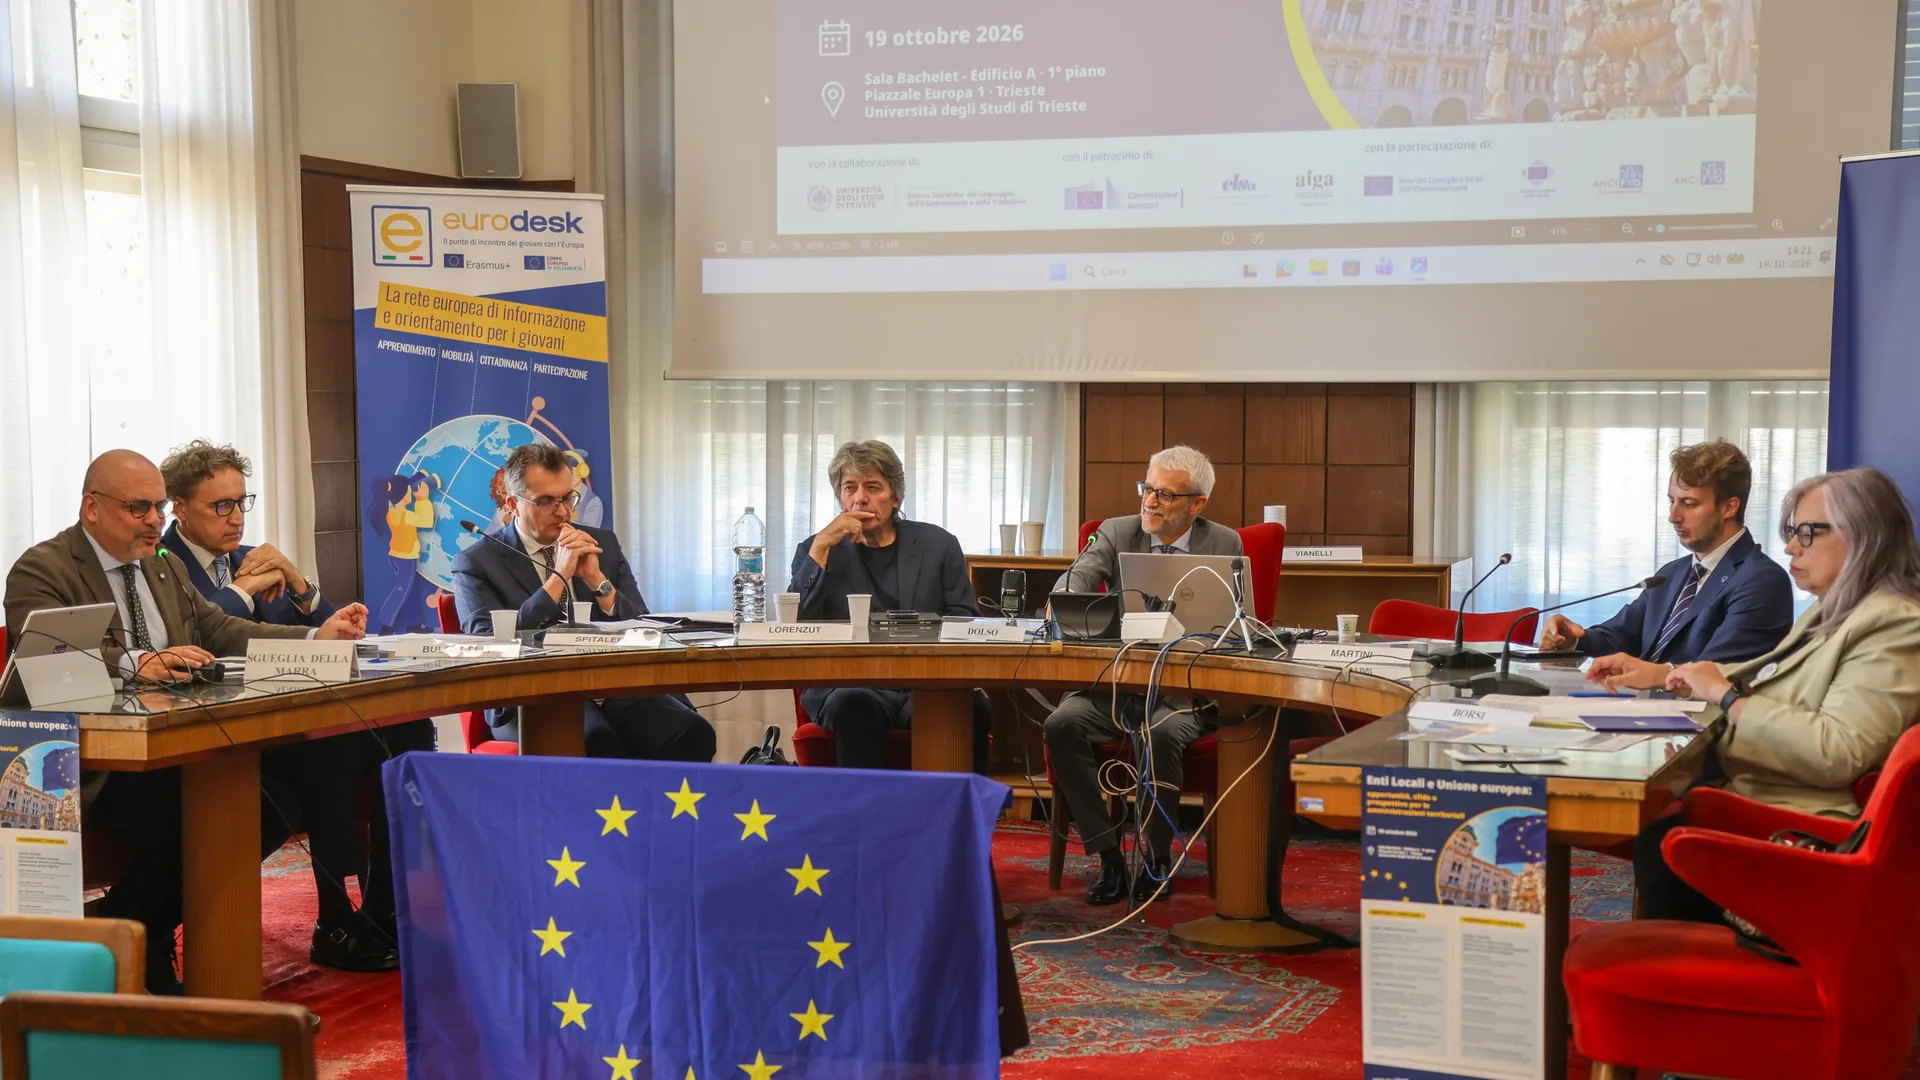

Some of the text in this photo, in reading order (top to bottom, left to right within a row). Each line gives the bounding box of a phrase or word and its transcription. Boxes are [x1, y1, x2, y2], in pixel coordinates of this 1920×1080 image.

[864, 24, 1024, 47] 19 ottobre 2026
[865, 72, 894, 85] Sala
[897, 70, 959, 84] Bachelet
[971, 67, 1022, 82] Edificio
[1026, 67, 1036, 80] A
[1048, 66, 1062, 79] 1°
[1065, 65, 1106, 81] piano
[865, 88, 921, 102] Piazzale
[925, 86, 973, 101] Europa
[977, 87, 984, 98] 1
[996, 84, 1045, 97] Trieste
[865, 99, 1087, 118] Università degli Studi di Trieste
[1365, 140, 1493, 154] con la partecipazione di:
[809, 160, 826, 169] con
[828, 157, 836, 168] la
[839, 156, 906, 168] collaborazione
[1063, 150, 1155, 164] con il patrocinio di:
[1222, 174, 1256, 192] elsa
[1295, 170, 1334, 190] aiga
[1593, 179, 1617, 188] ANCI
[1673, 175, 1698, 185] ANCI
[1128, 190, 1178, 200] Commissione
[836, 200, 876, 209] DI TRIESTE
[1128, 201, 1159, 211] europea
[443, 210, 584, 234] eurodesk
[449, 238, 469, 247] punto
[470, 238, 477, 246] di
[478, 239, 505, 247] incontro
[507, 239, 518, 247] dei
[519, 239, 542, 249] giovani
[557, 241, 584, 250] l'Europa
[1787, 246, 1812, 256] 14:21
[466, 260, 511, 270] Erasmus+
[1758, 258, 1812, 269] 19/10/2026
[1101, 265, 1127, 277] Cerca
[385, 285, 586, 333] La rete europea di informazione
[383, 311, 565, 351] e orientamento per i giovani
[377, 339, 588, 380] APPRENDIMENTO MOBILITÀ CITTADINANZA PARTECIPAZIONE
[768, 626, 821, 634] LORENZUT
[967, 627, 999, 636] DOLSO
[247, 653, 349, 664] SGUEGLIA DELLA
[1331, 649, 1373, 658] MARTINI
[275, 667, 317, 676] MARRA
[1452, 708, 1486, 720] BORSI
[0, 719, 68, 731] nione europea:
[1366, 775, 1389, 786] Enti
[1391, 776, 1425, 788] Locali
[1436, 780, 1478, 792] Unione
[1480, 784, 1532, 796] europea:
[1366, 799, 1408, 808] prospettive
[1366, 807, 1465, 819] amministrazioni territoriali
